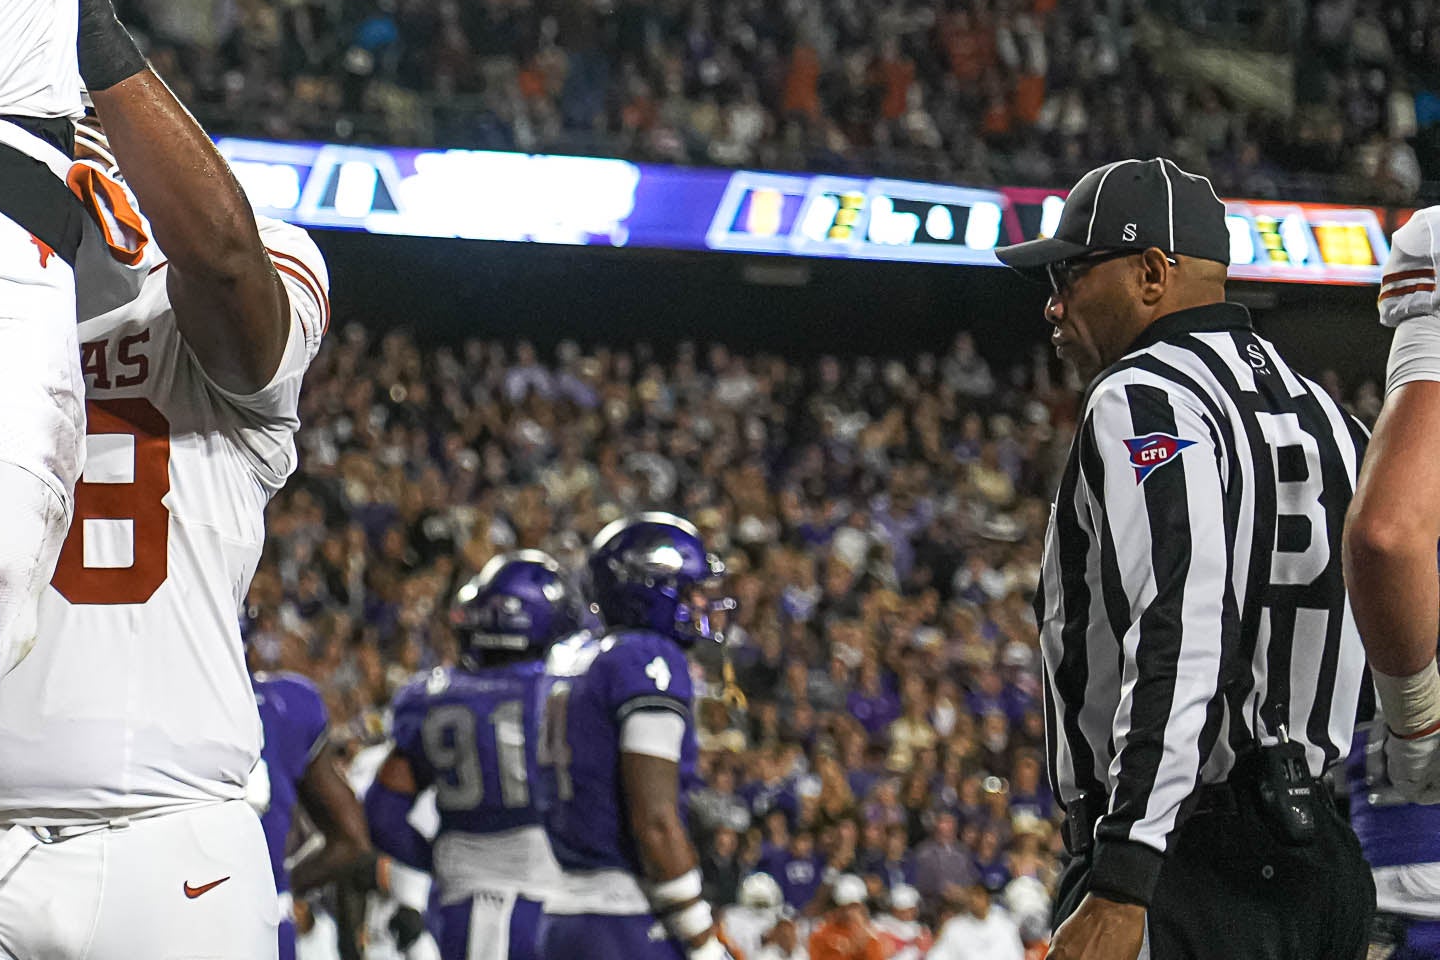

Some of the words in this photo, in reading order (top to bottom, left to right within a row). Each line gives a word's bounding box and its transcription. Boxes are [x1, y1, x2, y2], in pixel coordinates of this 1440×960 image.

[1141, 447, 1168, 461] CFO
[1256, 412, 1330, 585] B
[645, 656, 671, 690] 4
[421, 700, 531, 811] 91
